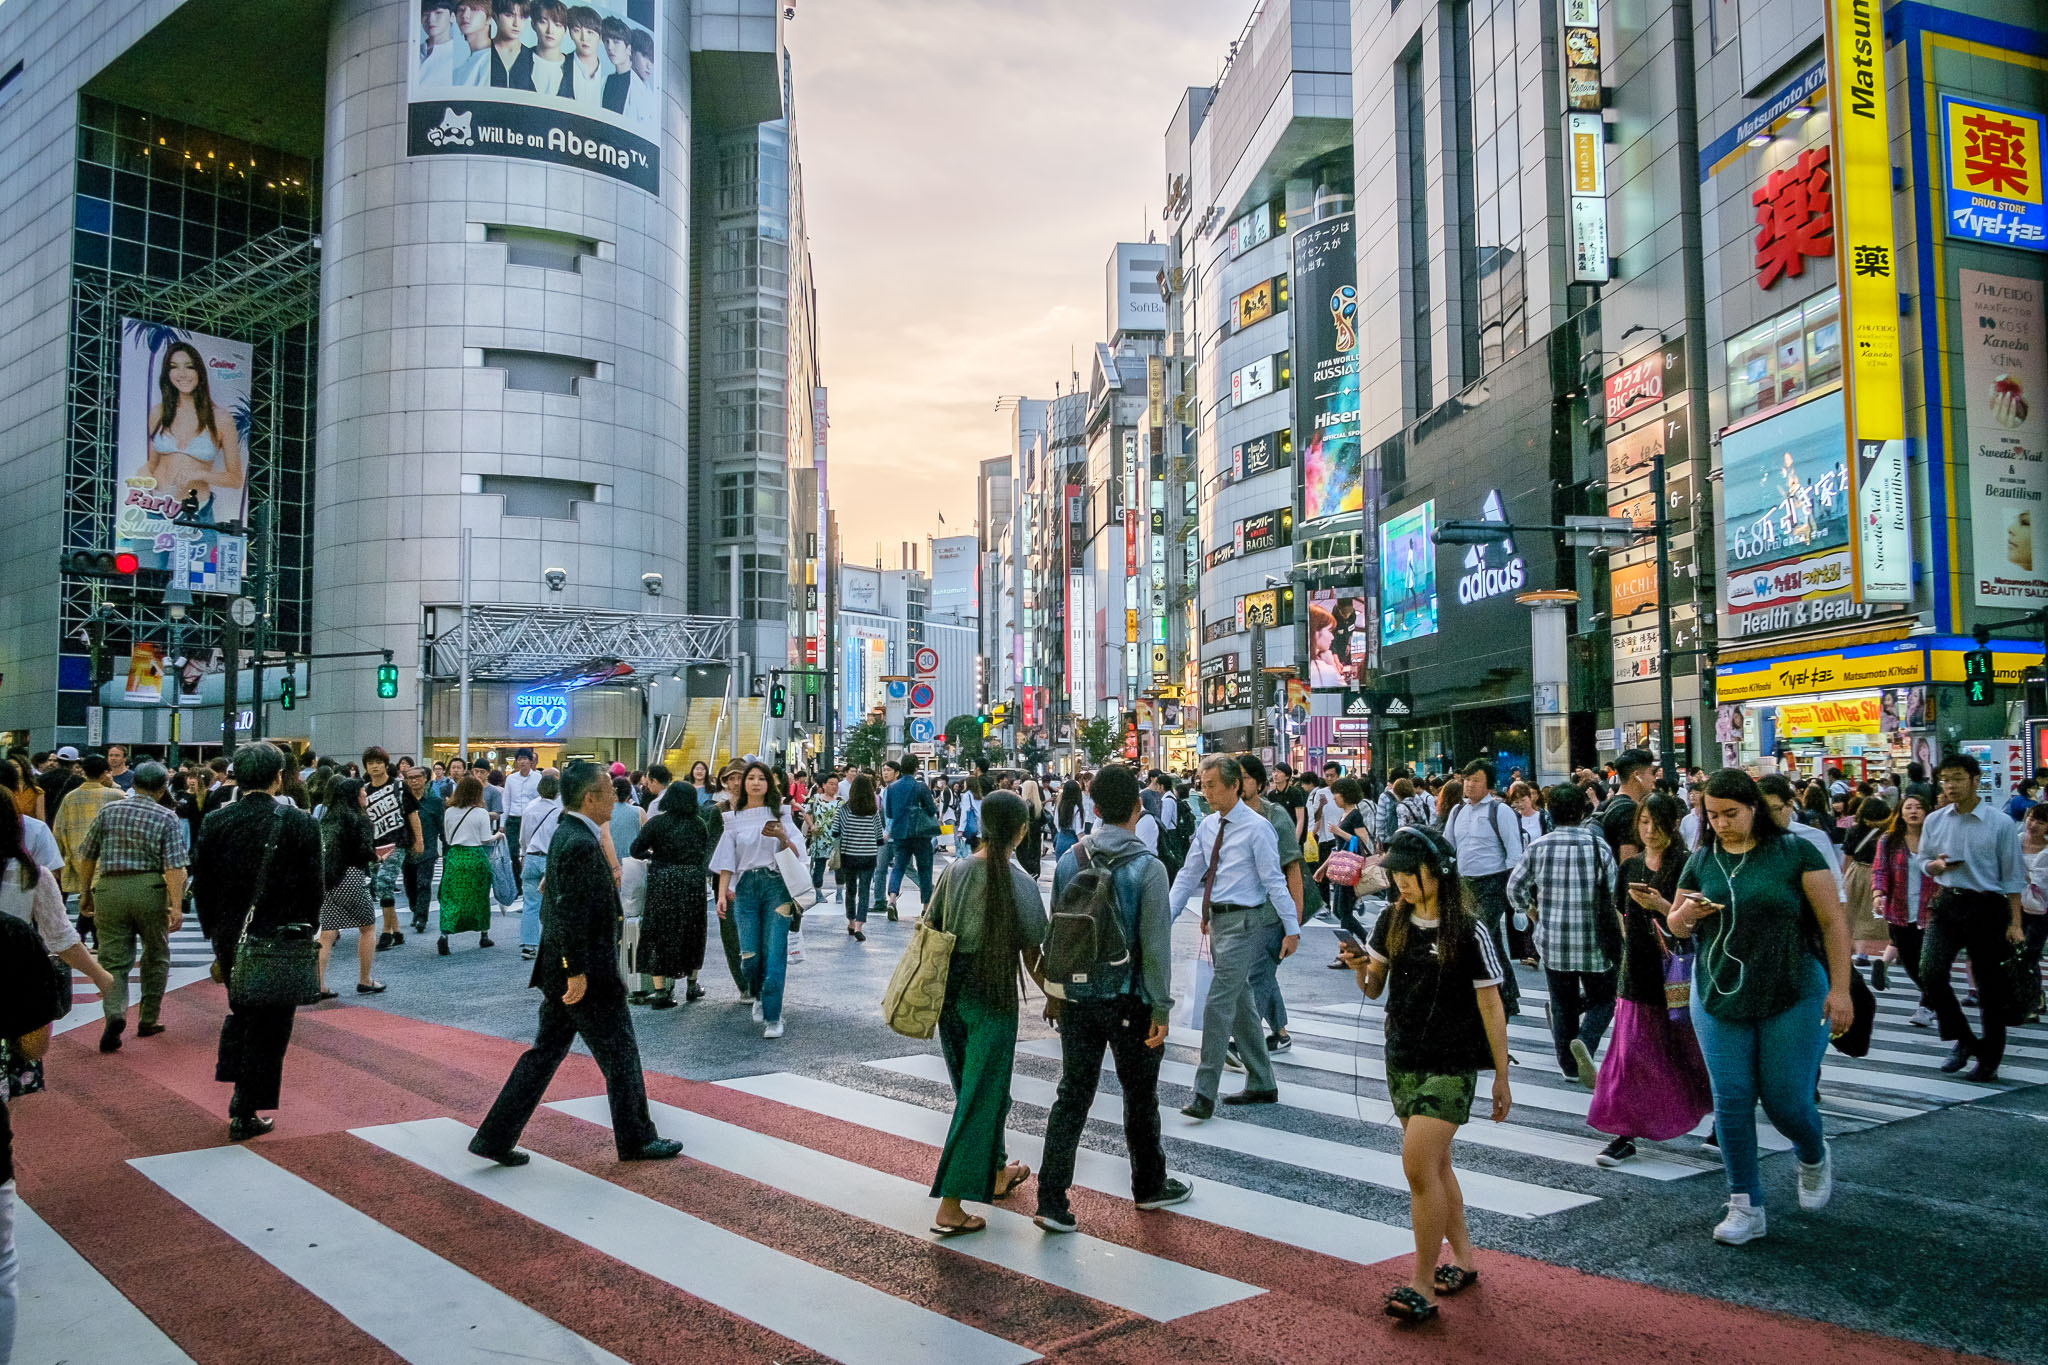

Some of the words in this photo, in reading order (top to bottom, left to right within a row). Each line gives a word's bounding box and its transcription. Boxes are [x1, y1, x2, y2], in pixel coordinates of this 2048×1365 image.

[1736, 86, 1803, 144] Matsumoto
[478, 126, 504, 144] Will
[507, 128, 523, 145] be
[527, 135, 544, 148] on
[1963, 114, 2030, 196] 薬
[1971, 196, 1996, 210] DRUG
[1998, 202, 2026, 215] STORE
[1752, 145, 1834, 291] 薬
[1953, 207, 2046, 243] マツモトキヨシ
[1854, 245, 1890, 277] 薬
[1975, 282, 2033, 302] SHISEIDO
[1983, 334, 2029, 352] Kanebo
[1318, 360, 1332, 369] FIFA
[1332, 354, 1360, 365] WORLD
[1314, 364, 1354, 383] RUSSIA
[1614, 362, 1653, 394] カラオケ
[1608, 391, 1628, 417] BIG
[1323, 433, 1346, 441] OFFICIAL
[1863, 445, 1878, 458] 4F
[1979, 444, 2016, 461] Sweetie
[2019, 450, 2045, 463] Nail
[2008, 465, 2015, 474] &
[126, 488, 181, 518] Early
[1893, 459, 1904, 531] Beautilism
[1985, 484, 2042, 501] Beautilism
[155, 534, 207, 561] Dys
[1246, 535, 1273, 551] BAGUS
[1735, 519, 1763, 560] 6.8
[1873, 523, 1885, 572] Sweetie
[1459, 558, 1522, 604] adidas
[1980, 580, 2022, 596] BEAUTY
[1741, 606, 1790, 634] Health
[1795, 602, 1808, 624] &
[1811, 600, 1874, 623] Beauty
[920, 654, 934, 666] 30
[1843, 670, 1887, 682] Matsumoto
[1888, 664, 1919, 677] KiYoshi
[517, 695, 567, 706] SHIBUYA
[514, 706, 569, 736] 109
[1811, 705, 1835, 723] Tax
[1832, 703, 1860, 722] Free
[916, 724, 926, 739] P
[2009, 746, 2024, 798] KIR
